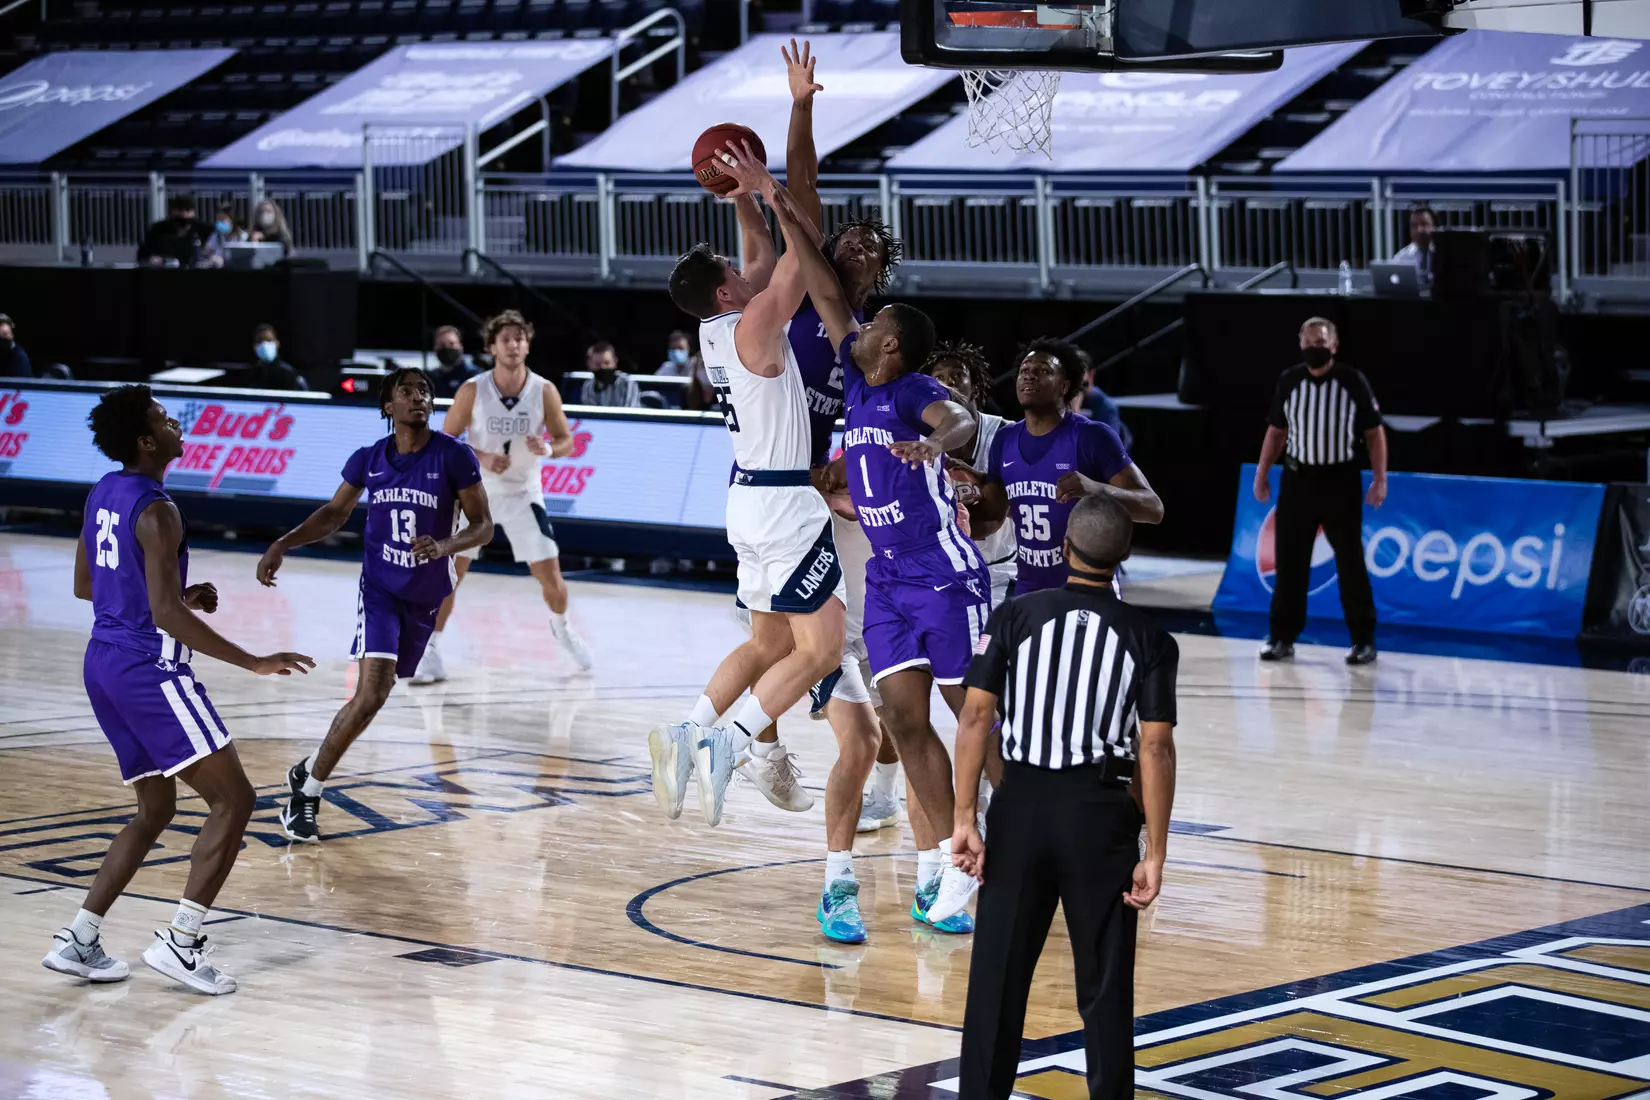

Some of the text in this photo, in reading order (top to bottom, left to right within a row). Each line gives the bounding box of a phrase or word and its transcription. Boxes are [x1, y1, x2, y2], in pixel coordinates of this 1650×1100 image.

[805, 386, 845, 415] STAT
[189, 402, 295, 440] Bud's
[486, 416, 531, 436] CBU
[208, 446, 296, 490] PROS
[540, 464, 595, 495] ROS
[860, 454, 873, 498] 1
[1005, 481, 1058, 500] TARLETO
[96, 508, 120, 570] 25
[390, 508, 416, 544] 13
[1018, 504, 1051, 541] 35
[795, 547, 834, 600] LANCERS
[1019, 546, 1063, 567] STATE
